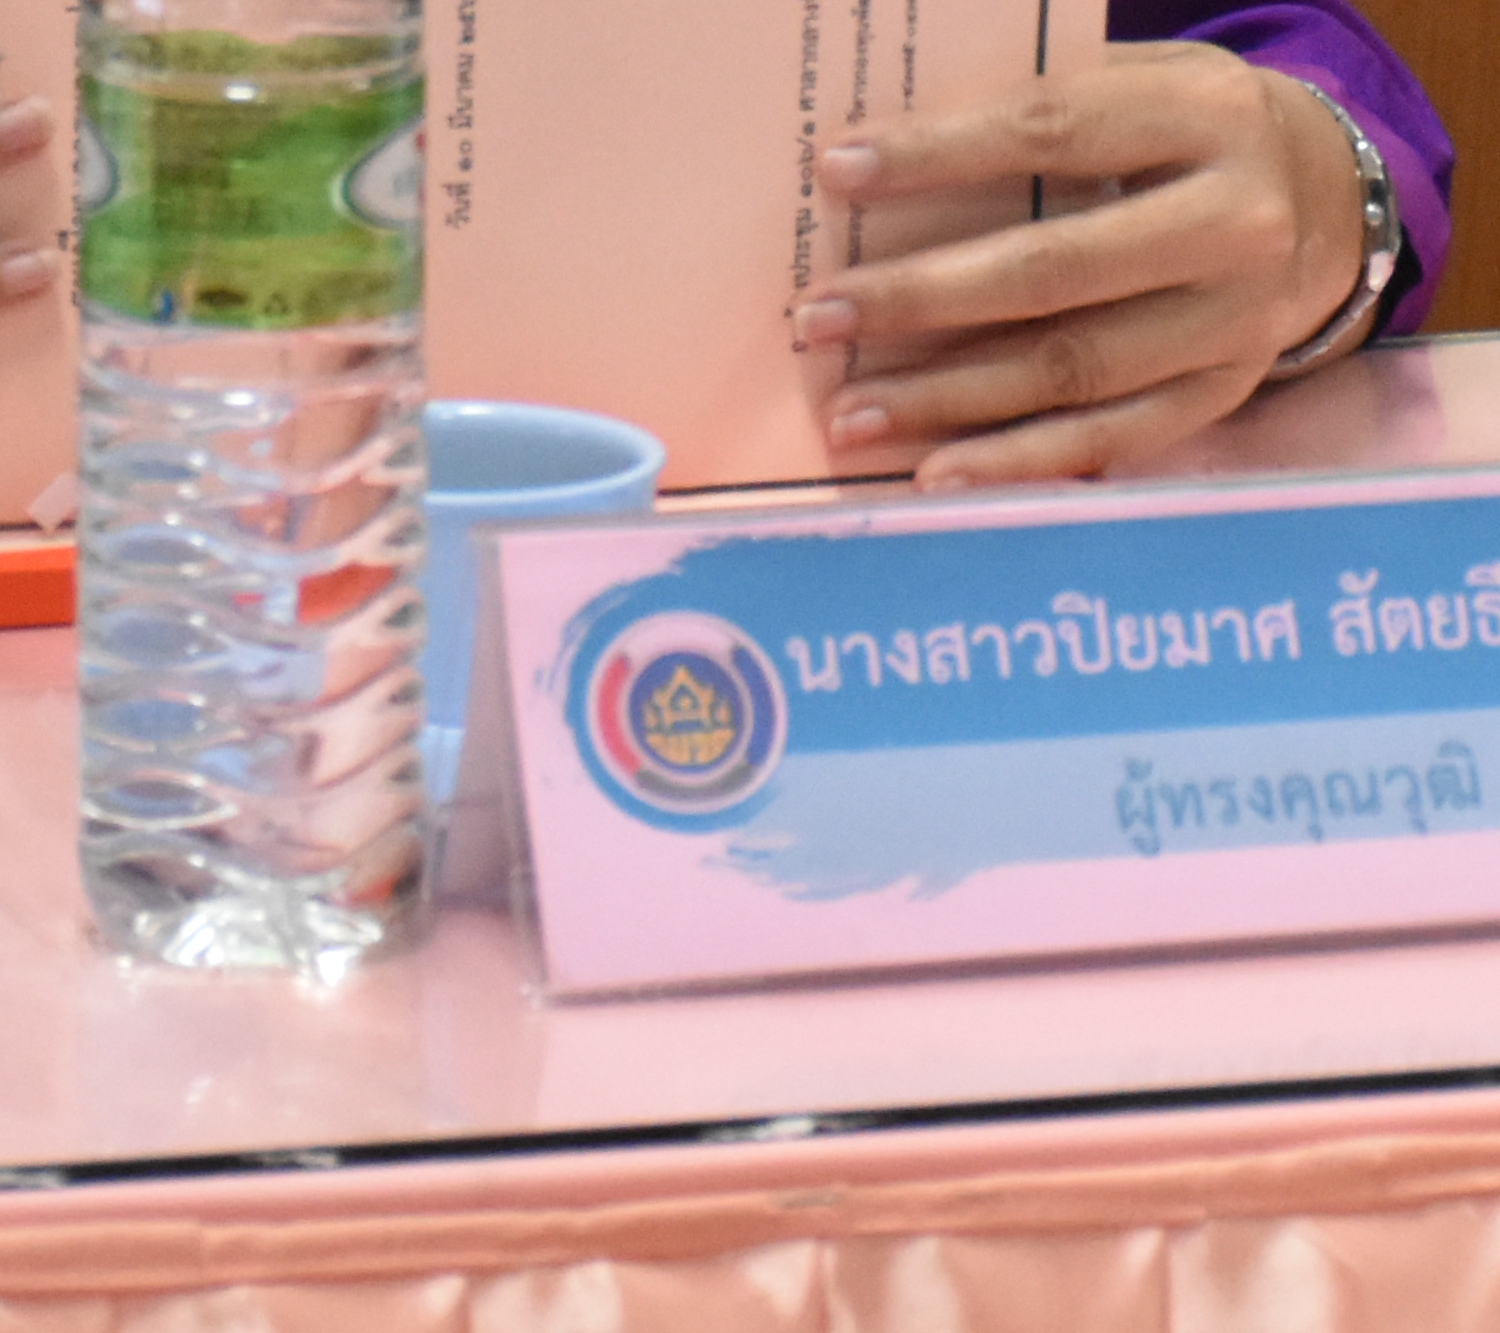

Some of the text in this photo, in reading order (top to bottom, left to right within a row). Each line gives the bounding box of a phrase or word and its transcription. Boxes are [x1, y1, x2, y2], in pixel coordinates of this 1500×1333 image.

[785, 586, 1299, 696] นางสาวปิยมาศ
[1112, 740, 1484, 856] ผู้ทรงคุณวุฒิ
